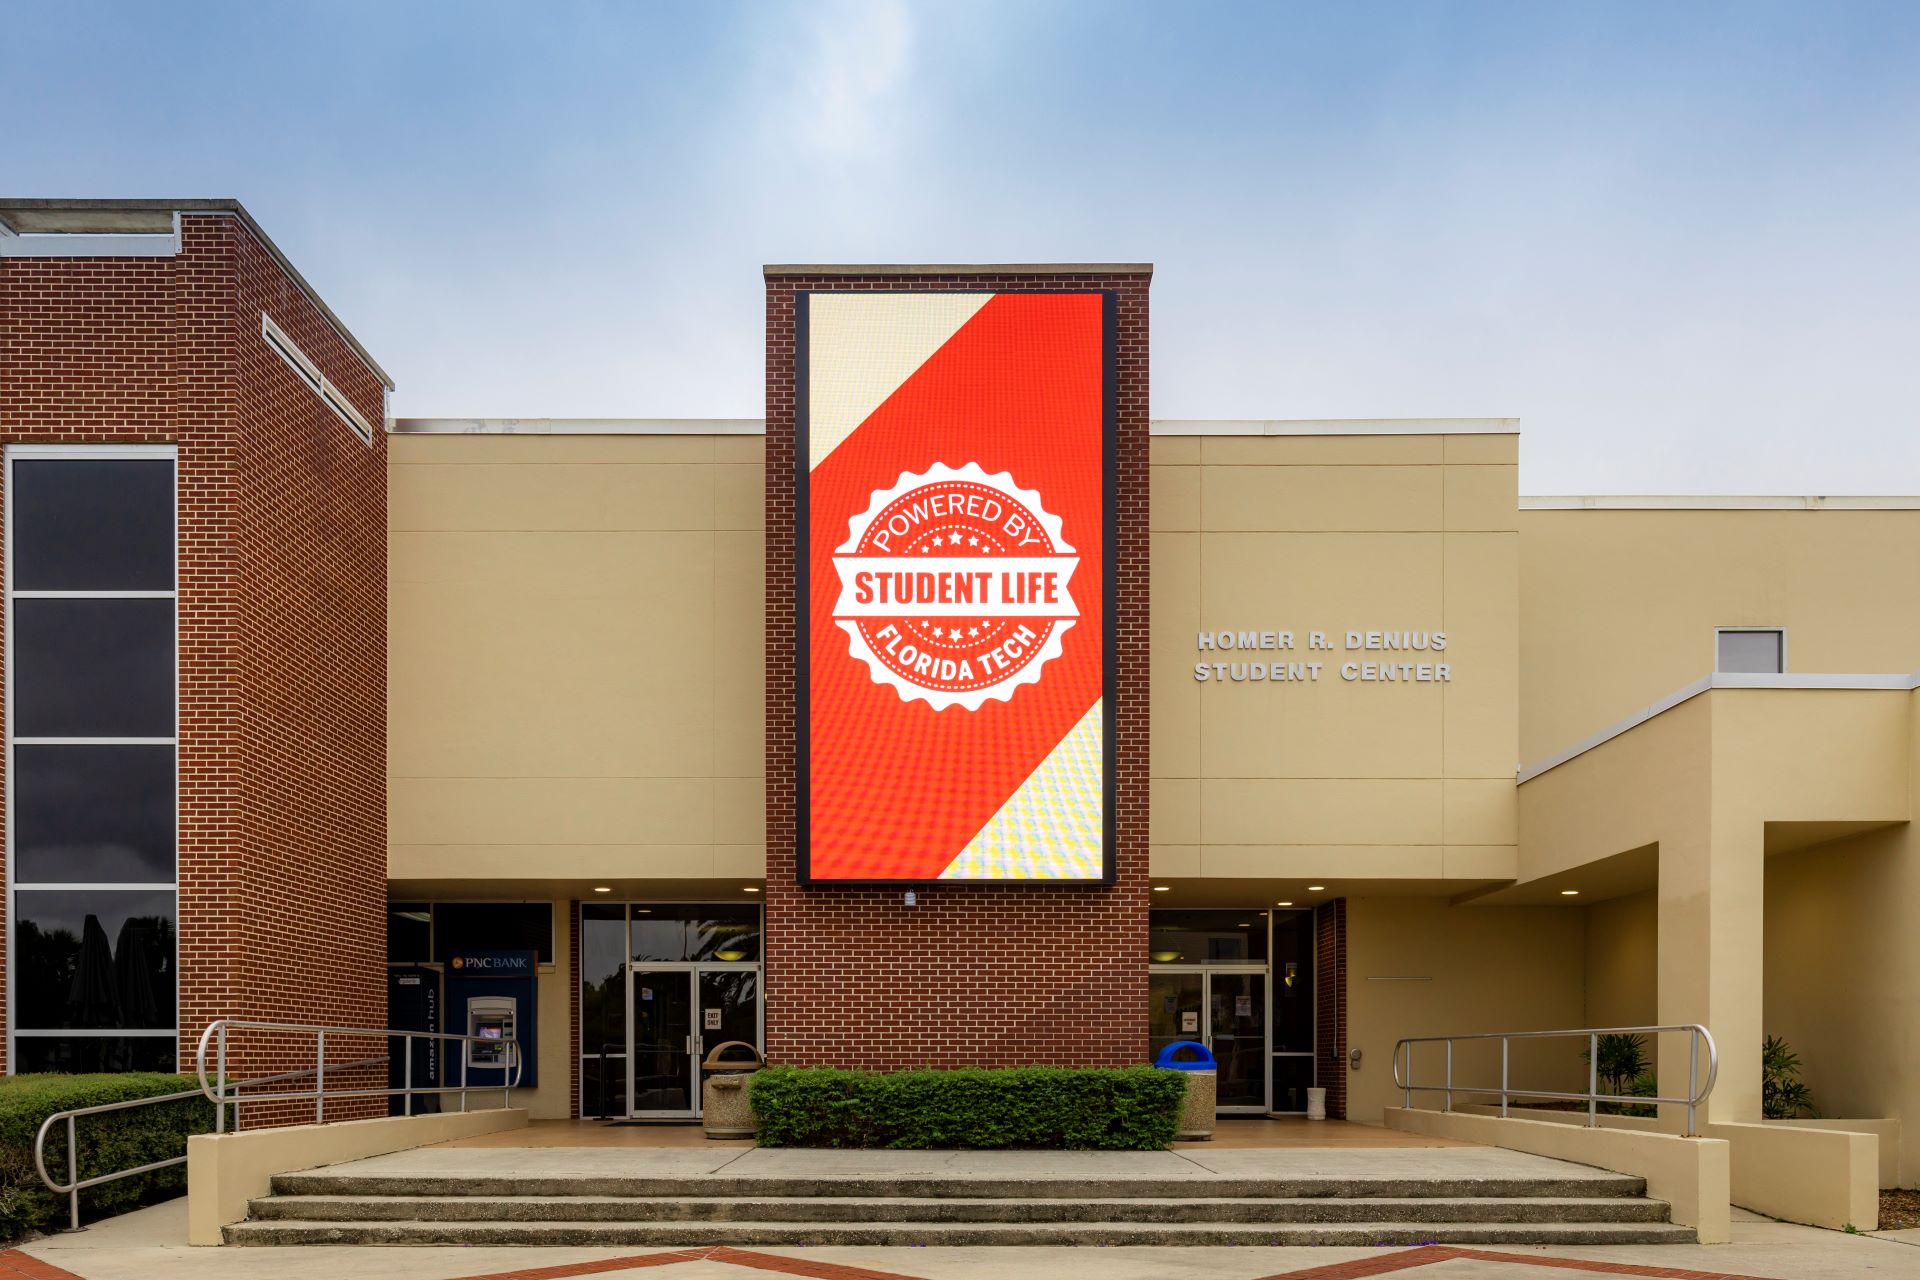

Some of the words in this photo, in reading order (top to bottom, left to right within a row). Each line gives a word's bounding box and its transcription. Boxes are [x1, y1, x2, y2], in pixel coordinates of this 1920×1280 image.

[872, 493, 1002, 552] POWERED
[1003, 513, 1040, 547] BY
[855, 571, 992, 604] STUDENT
[1001, 572, 1058, 604] LIFE
[876, 624, 974, 680] FLORIDA
[976, 624, 1036, 674] TECH
[1198, 631, 1294, 650] HOMER
[1309, 631, 1334, 649] R.
[1345, 631, 1447, 651] DENIUS
[1194, 662, 1322, 681] STUDENT
[1340, 662, 1451, 682] CENTER
[465, 957, 492, 968] PNC
[493, 957, 527, 968] BANK
